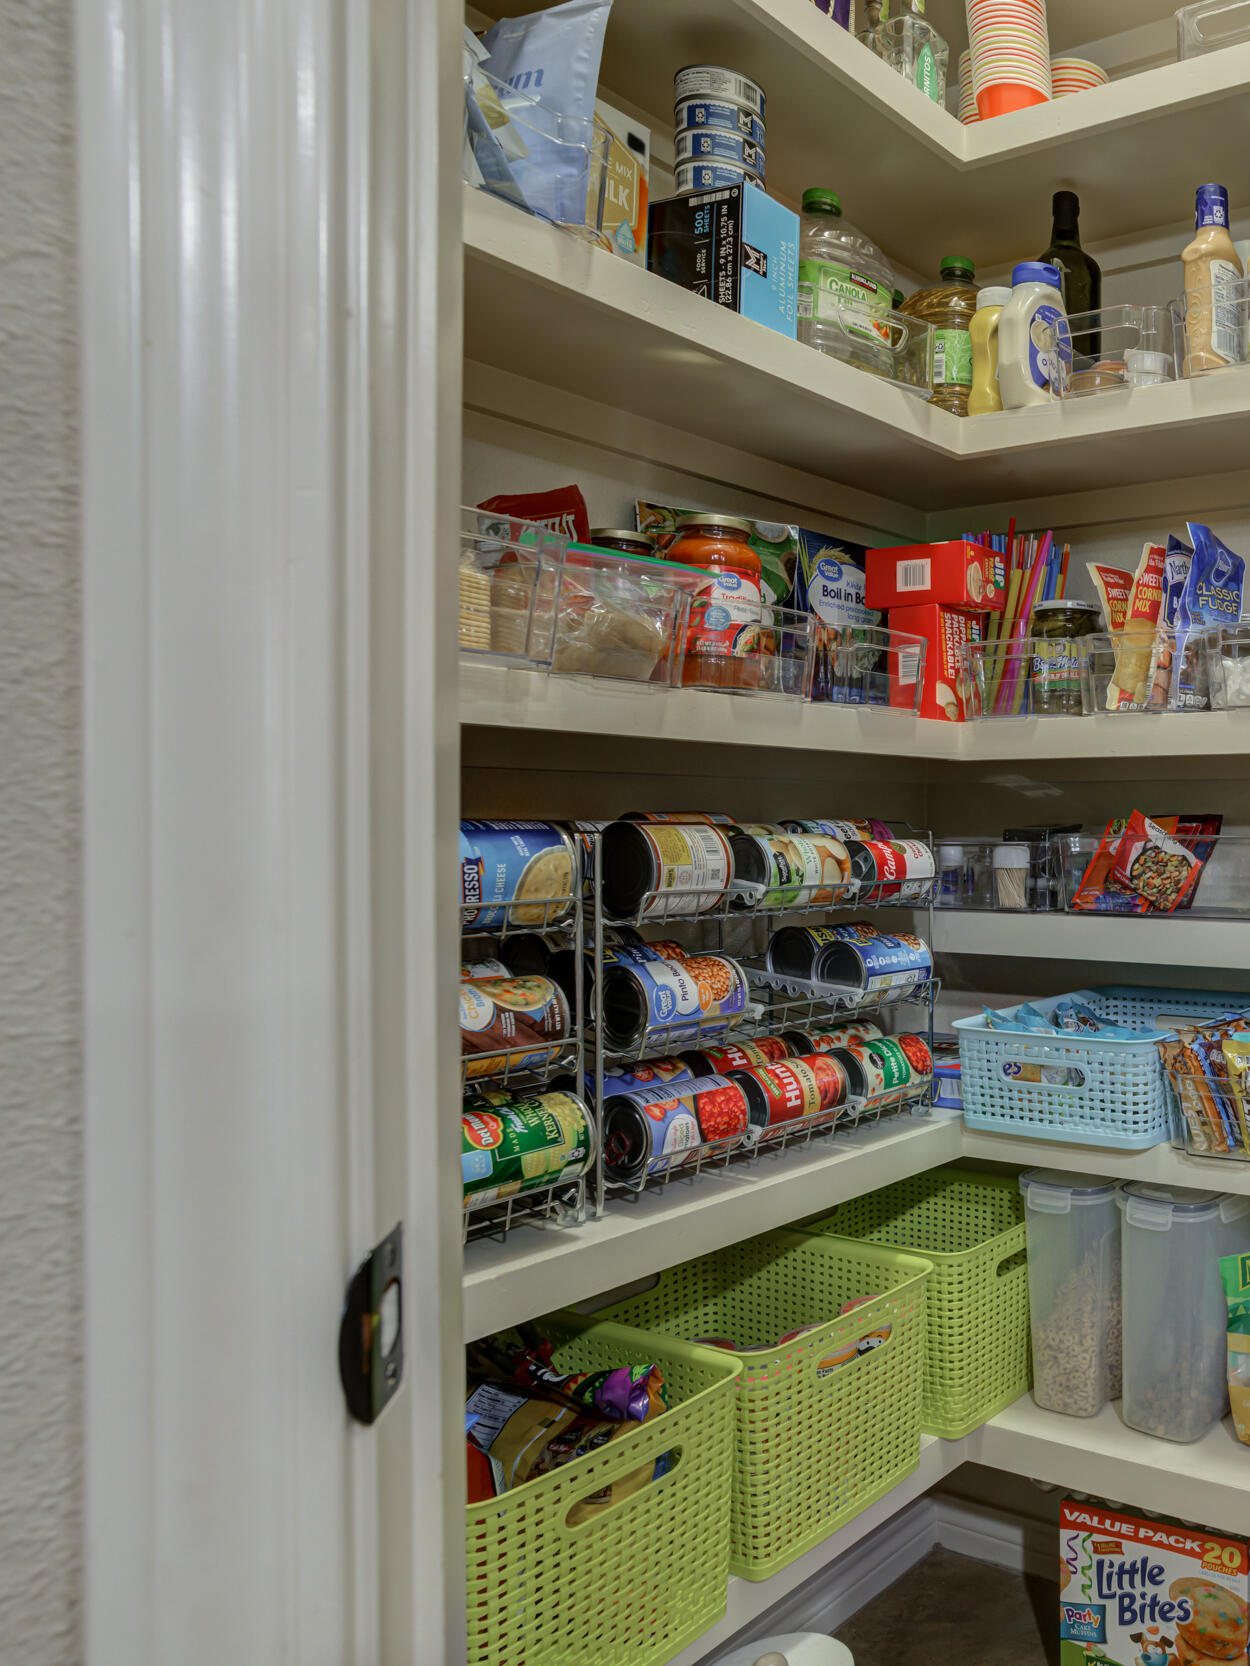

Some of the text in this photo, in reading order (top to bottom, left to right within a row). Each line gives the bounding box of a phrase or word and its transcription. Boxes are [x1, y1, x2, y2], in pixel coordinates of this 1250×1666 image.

[615, 163, 632, 179] MIX
[703, 204, 711, 233] SHEETS
[720, 205, 728, 216] IN
[694, 211, 704, 234] 500
[720, 216, 728, 238] 10.75
[720, 246, 727, 256] IN
[725, 237, 733, 254] 27.3
[718, 271, 726, 303] SHEETS
[778, 240, 786, 314] ALUMINUM
[785, 241, 796, 322] FOIL SHEETS
[828, 277, 867, 302] CANOLA
[819, 561, 840, 574] Great
[822, 584, 842, 600] Boil
[843, 588, 854, 602] in
[1196, 581, 1241, 603] CLASSIC
[818, 599, 845, 611] Enriched
[1134, 599, 1151, 613] MIX
[1199, 596, 1239, 616] FUDGE
[951, 613, 961, 669] PACKABLE
[495, 863, 507, 893] CHEESE
[463, 864, 480, 925] PRORESSO
[665, 989, 673, 1009] Value
[678, 978, 689, 1002] Pinto
[659, 991, 668, 1017] Great
[887, 1060, 899, 1085] Petite
[800, 1066, 816, 1109] Tomato
[477, 1128, 494, 1146] Del
[506, 1127, 520, 1152] MADE
[1063, 1508, 1136, 1536] VALUE
[1138, 1527, 1203, 1554] PACK
[1202, 1541, 1242, 1569] 20
[1096, 1555, 1166, 1601] Little
[1201, 1561, 1239, 1577] POUCHES
[1065, 1607, 1101, 1628] Party
[1117, 1591, 1193, 1627] Bites
[1069, 1627, 1098, 1639] MUFFINS
[1074, 1623, 1092, 1632] CAKE
